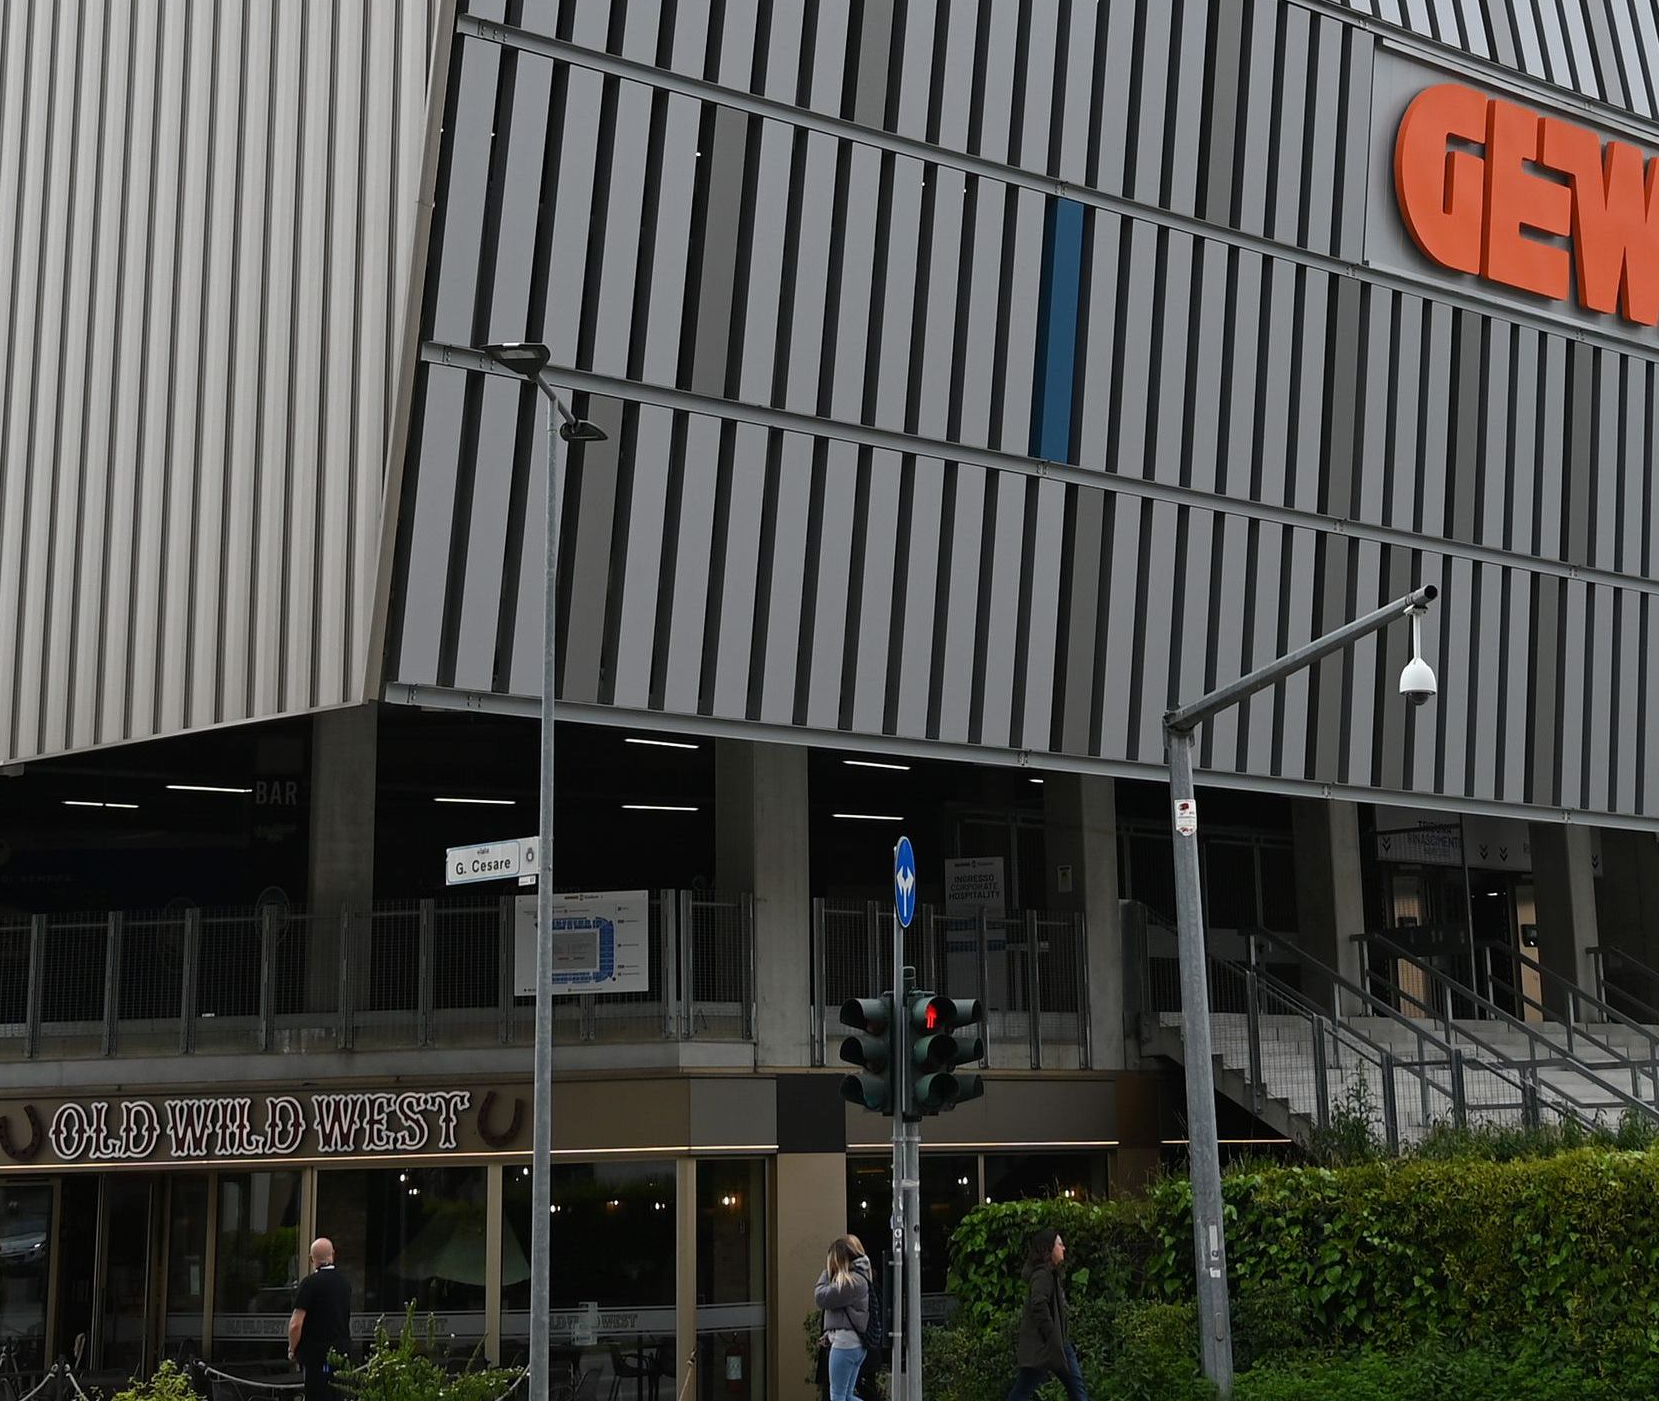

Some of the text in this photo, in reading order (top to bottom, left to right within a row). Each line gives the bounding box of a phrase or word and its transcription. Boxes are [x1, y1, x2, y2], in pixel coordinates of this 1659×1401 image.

[255, 780, 297, 806] BAR
[455, 858, 511, 875] G. Cesare
[954, 873, 994, 884] INGRESSO
[948, 891, 1000, 901] HOSPITALITY
[49, 1090, 471, 1160] OLD WILD WEST
